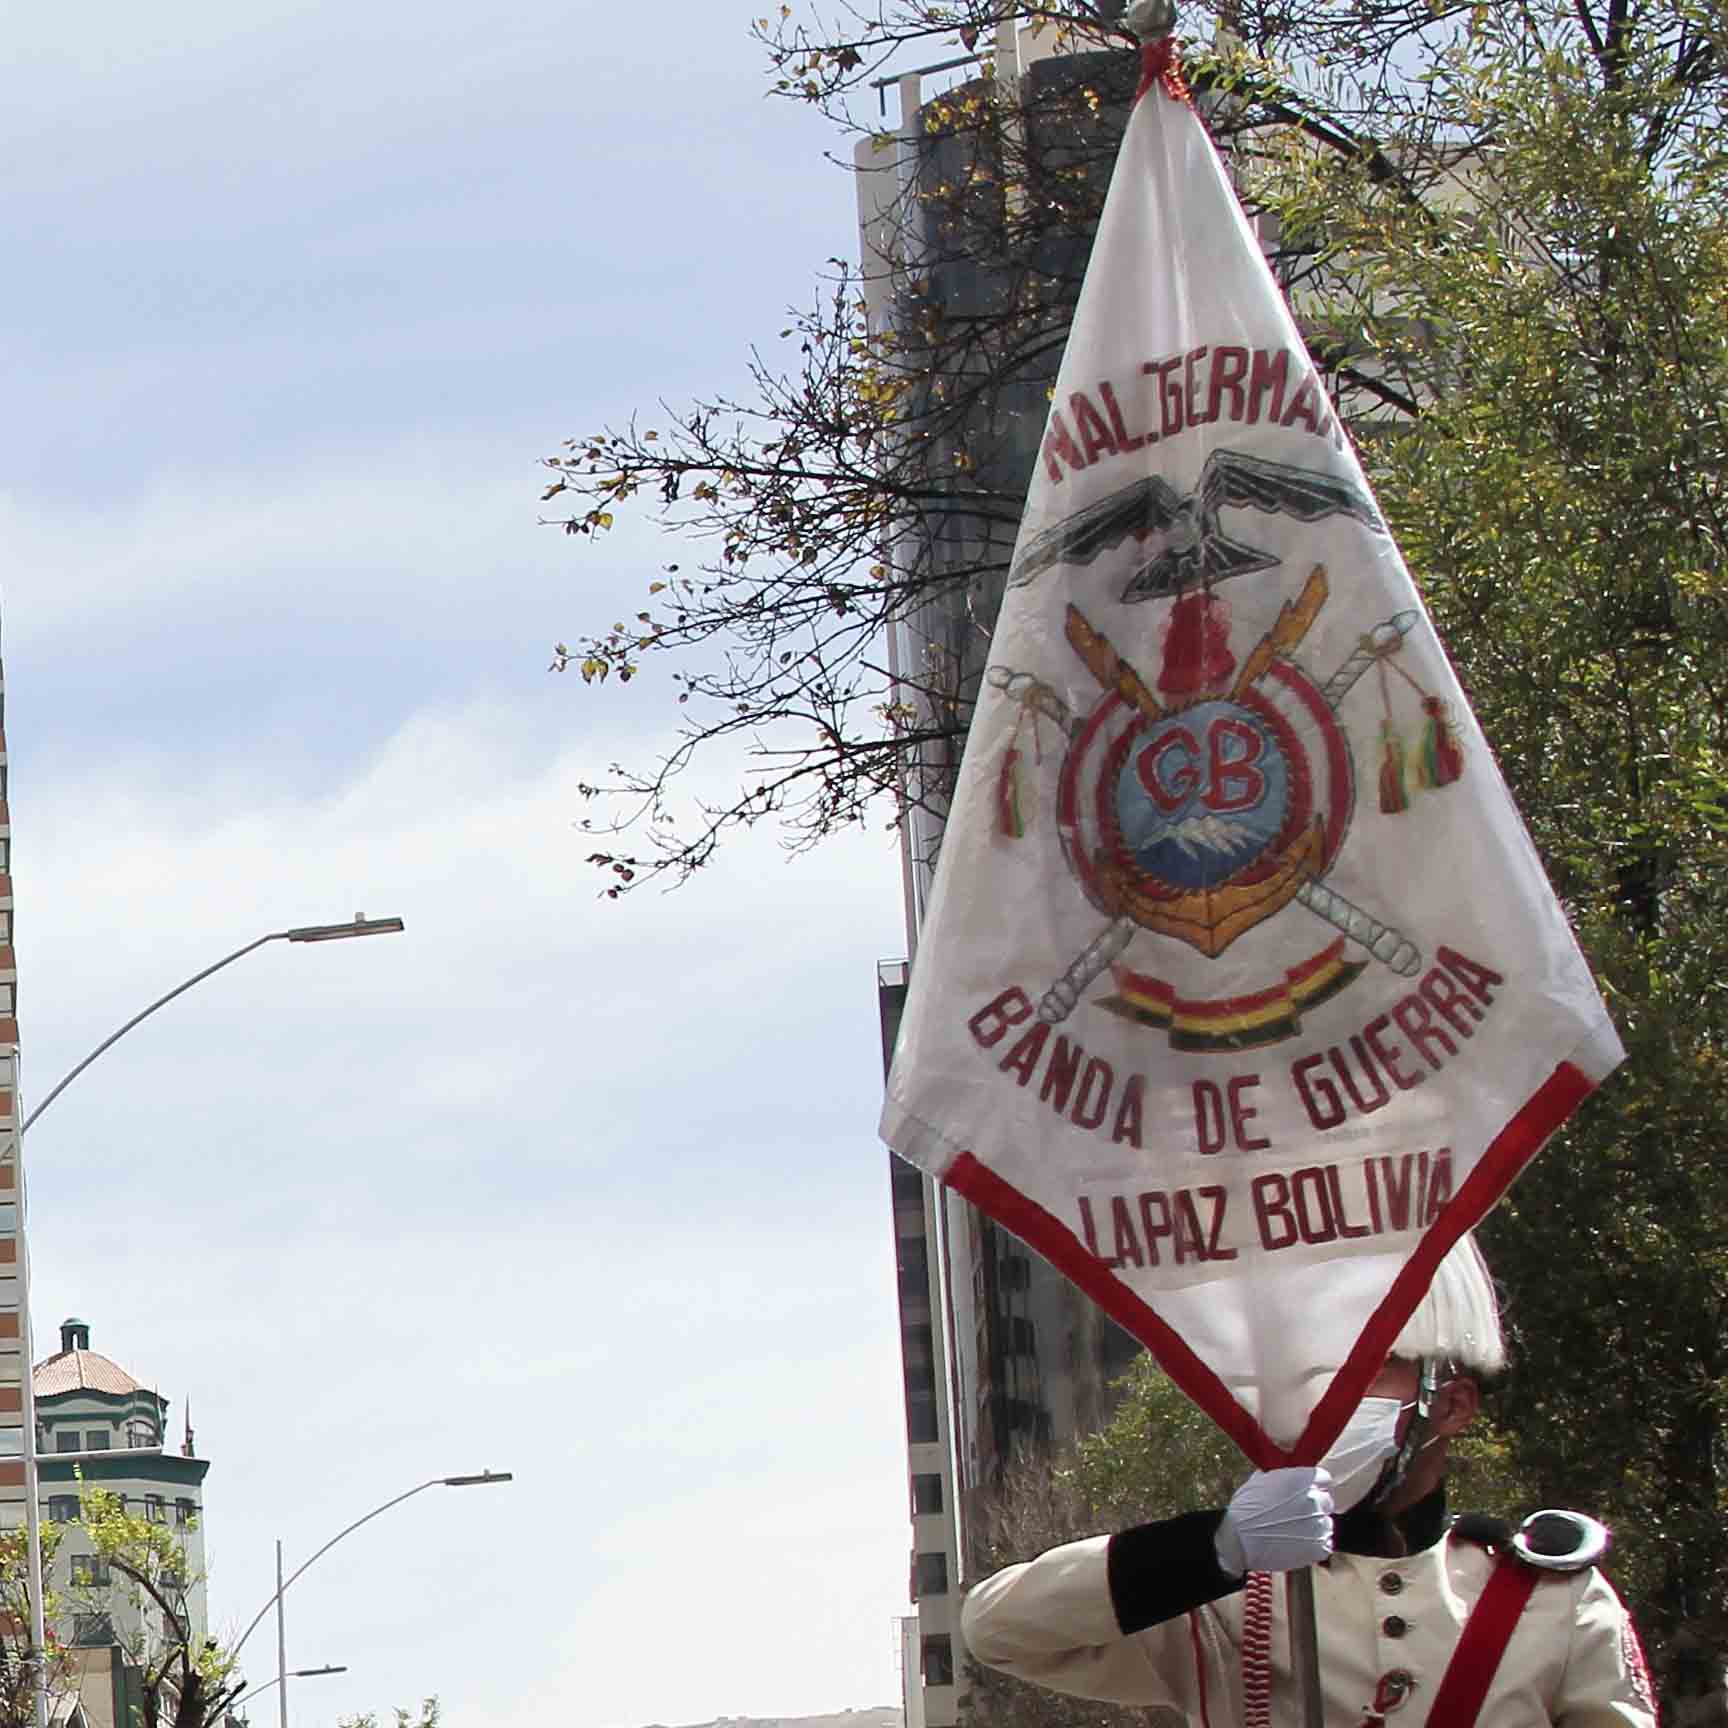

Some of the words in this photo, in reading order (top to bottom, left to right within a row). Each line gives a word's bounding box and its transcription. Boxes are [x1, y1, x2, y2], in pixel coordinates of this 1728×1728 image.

[1135, 716, 1265, 814] GB
[966, 984, 1148, 1150] BANDA
[1190, 1073, 1272, 1155] DE
[1289, 945, 1505, 1131] GUERRA
[1250, 1146, 1454, 1253] BOLIVIA
